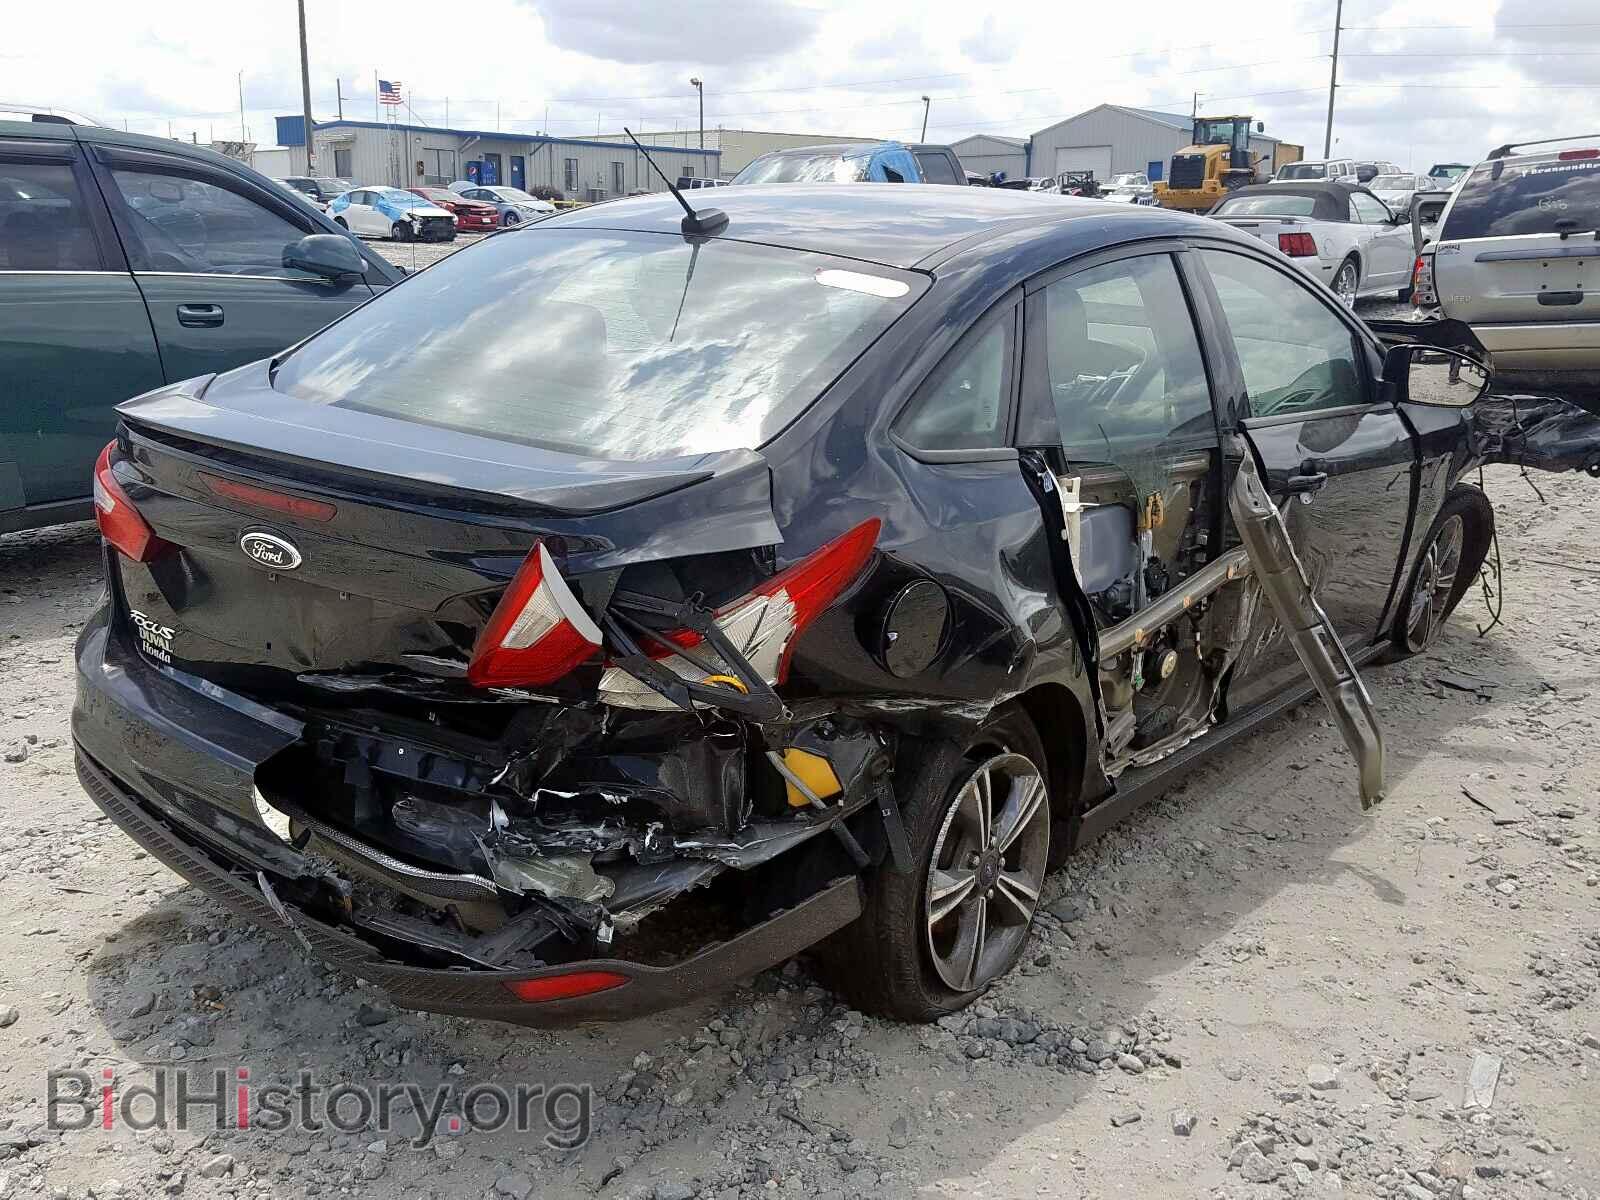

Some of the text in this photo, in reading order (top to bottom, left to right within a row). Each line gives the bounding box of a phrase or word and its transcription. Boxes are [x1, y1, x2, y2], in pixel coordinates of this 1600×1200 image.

[252, 540, 283, 564] Ford
[138, 626, 174, 653] DUVAL
[142, 640, 171, 664] Honda
